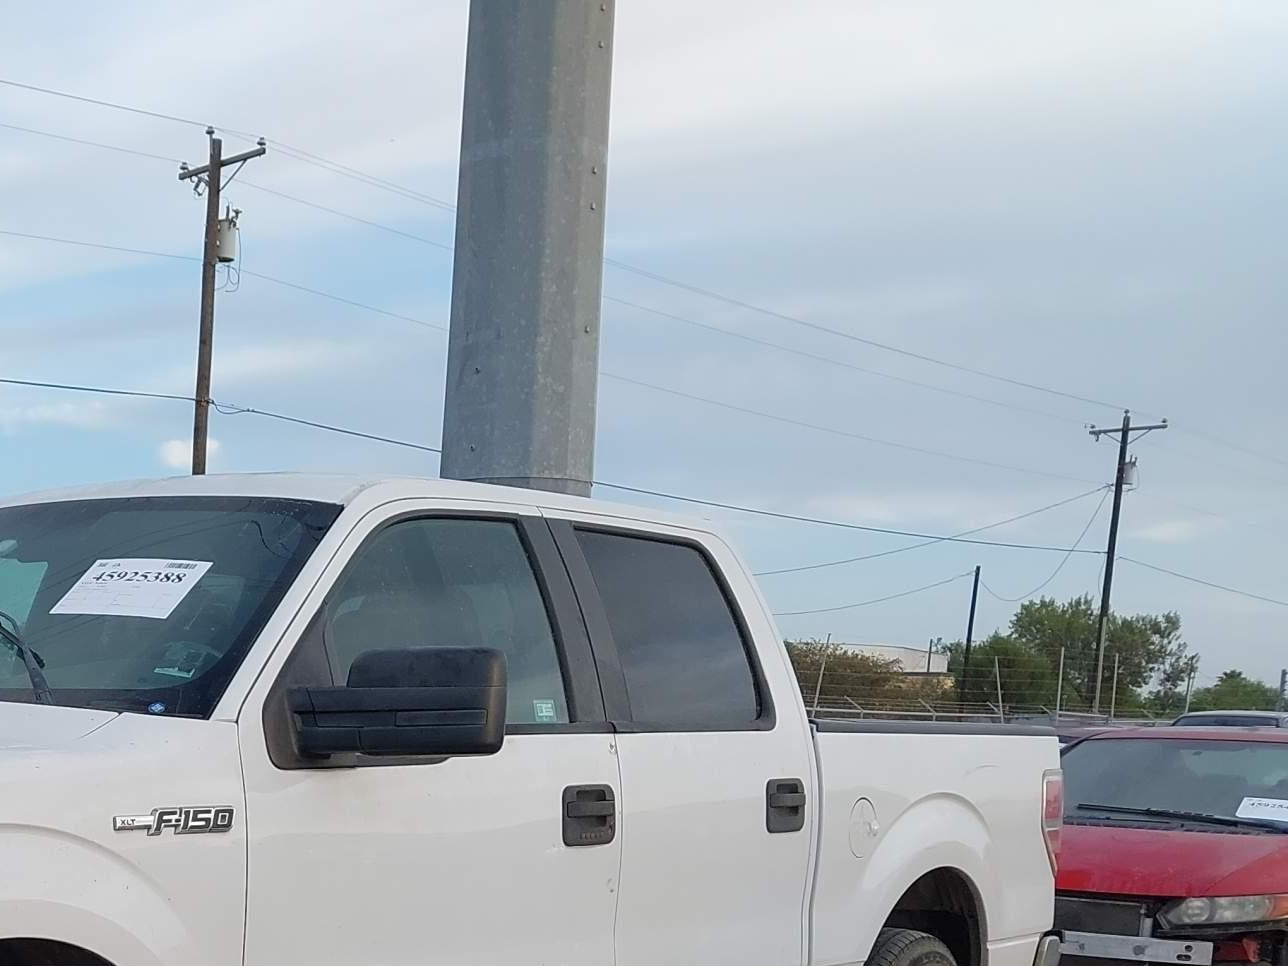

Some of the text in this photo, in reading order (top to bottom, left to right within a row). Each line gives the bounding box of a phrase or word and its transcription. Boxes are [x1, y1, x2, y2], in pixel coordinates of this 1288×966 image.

[92, 571, 187, 584] 45925388
[120, 806, 235, 834] XLT F-150
